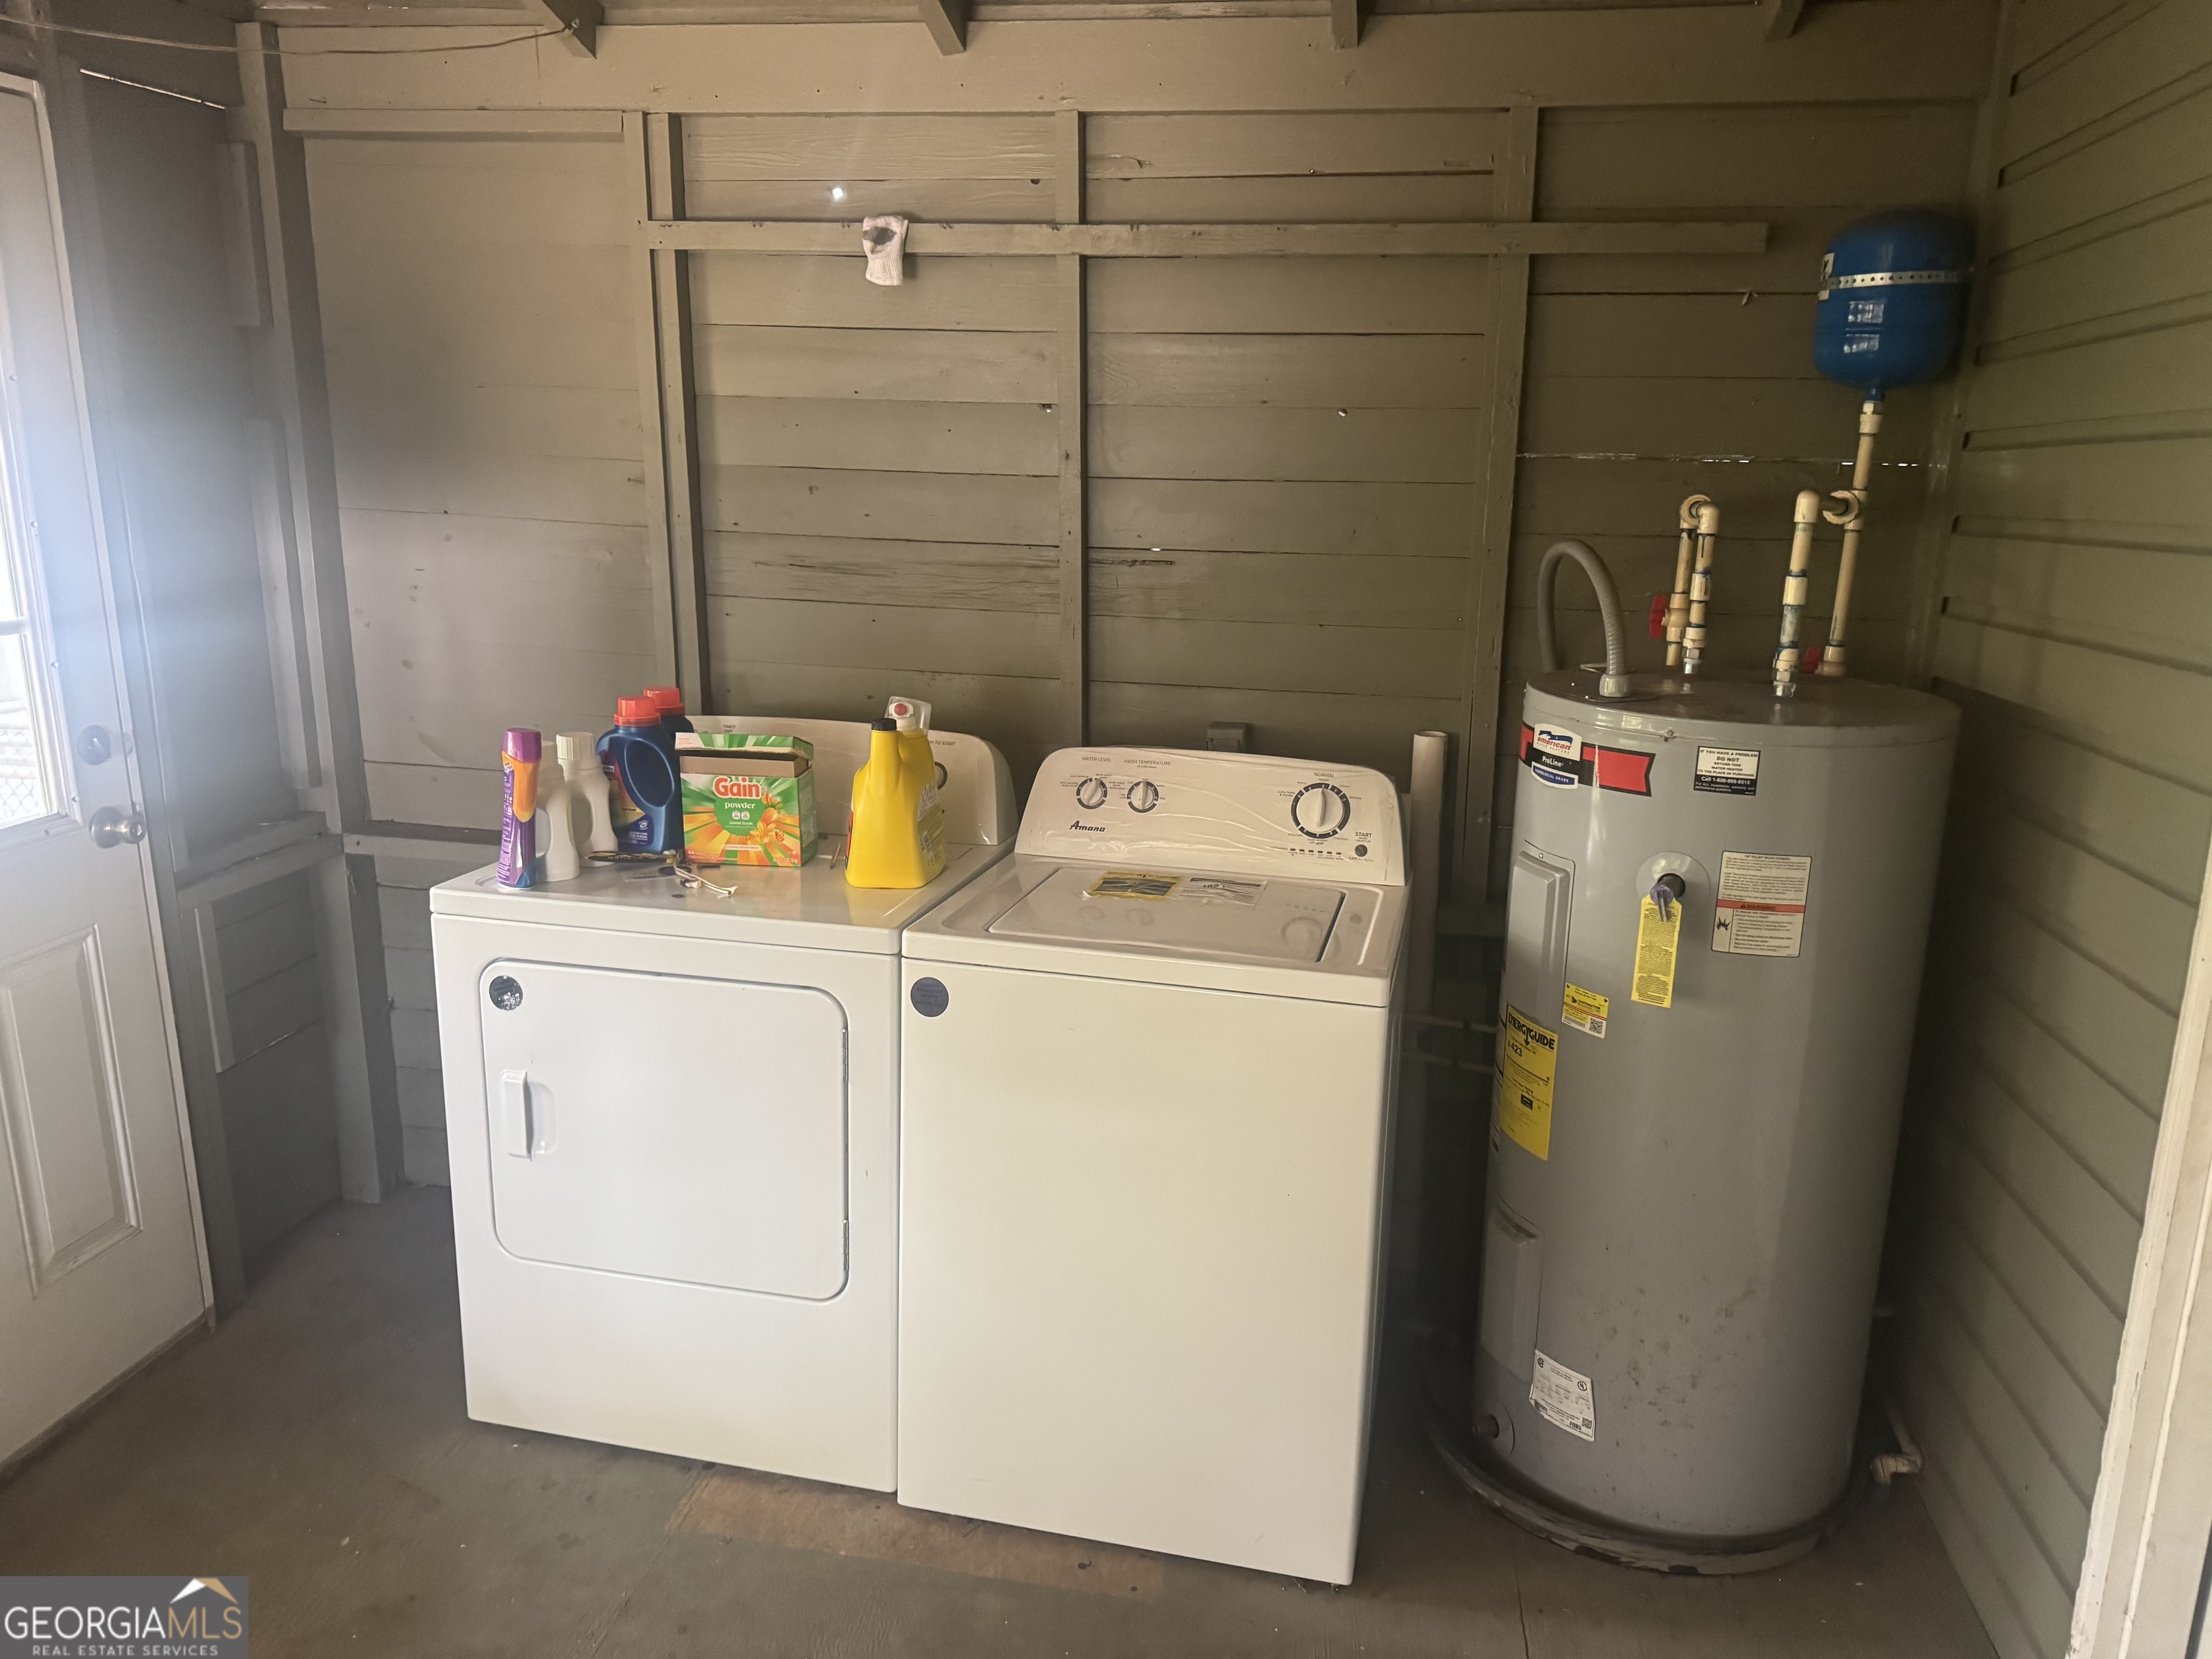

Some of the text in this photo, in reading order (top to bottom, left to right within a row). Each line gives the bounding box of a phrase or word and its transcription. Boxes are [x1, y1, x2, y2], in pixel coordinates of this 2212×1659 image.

[1537, 737, 1571, 751] american
[1542, 755, 1563, 768] ProLine
[714, 777, 760, 798] Gain
[1069, 820, 1106, 832] Amana
